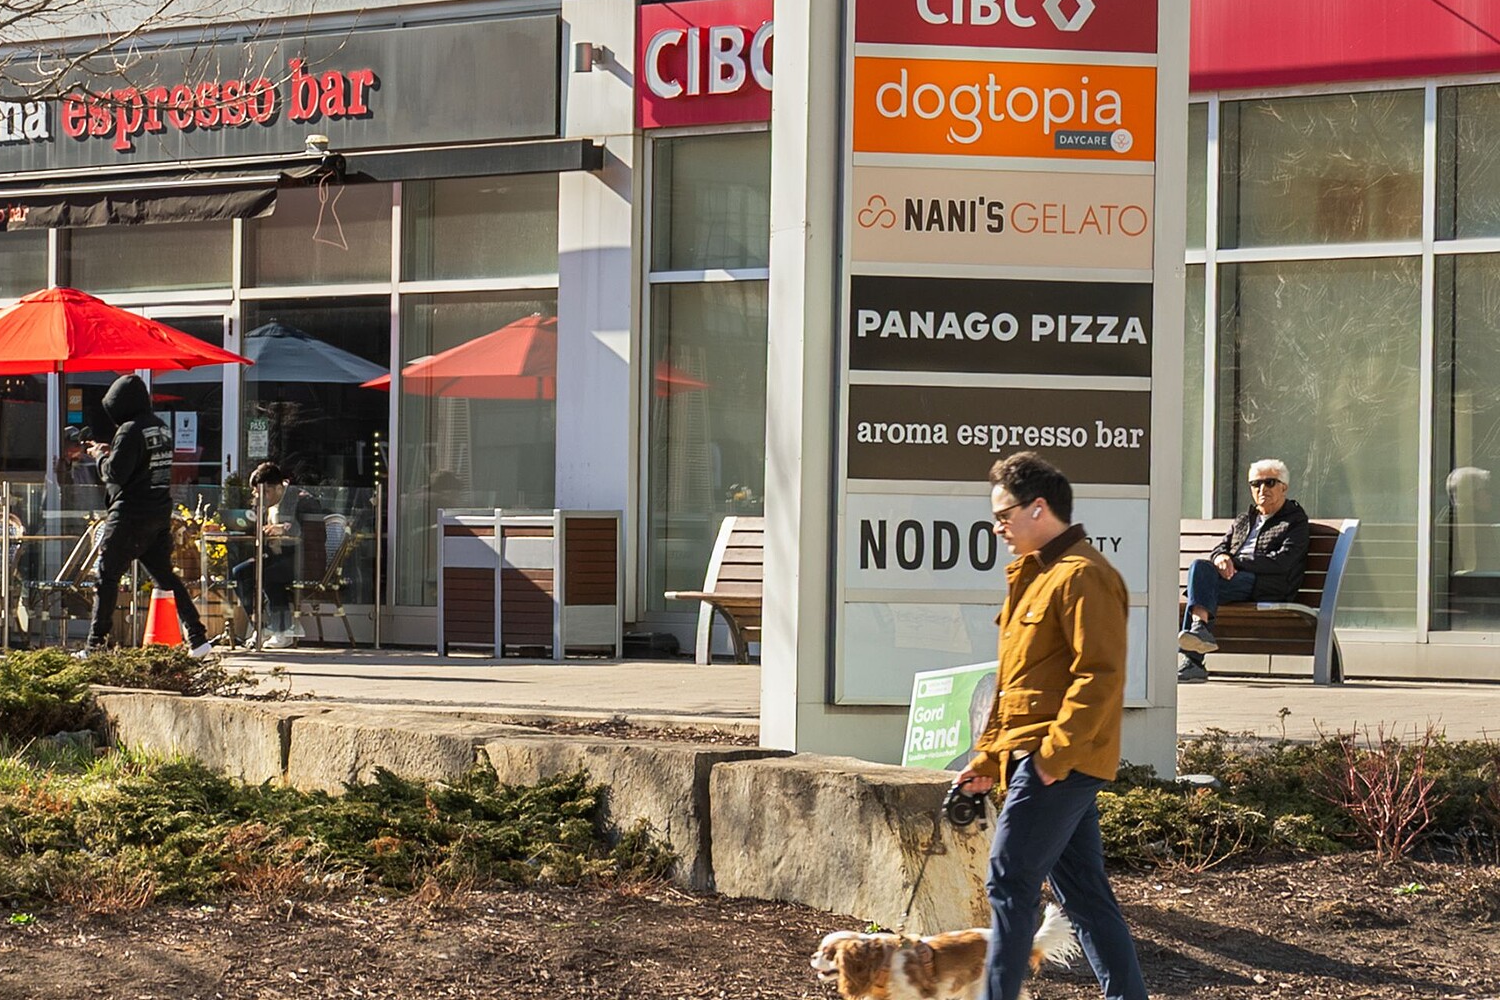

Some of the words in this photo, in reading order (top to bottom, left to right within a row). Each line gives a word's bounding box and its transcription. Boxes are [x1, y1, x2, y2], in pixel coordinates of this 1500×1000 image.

[62, 77, 276, 150] espresso
[288, 57, 375, 121] bar
[875, 68, 1123, 144] dogtopia
[1059, 134, 1107, 146] DAYCARE
[7, 203, 30, 222] bar
[904, 196, 1005, 234] NANI'S
[1010, 202, 1148, 237] GELATO
[857, 309, 1019, 342] PANAGO
[1031, 314, 1148, 345] PIZZA
[249, 420, 267, 431] PASS
[856, 421, 949, 445] aroma
[956, 423, 1088, 453] espresso
[1095, 420, 1145, 449] bar
[859, 519, 998, 571] NODO
[914, 703, 945, 724] Gord
[908, 719, 962, 753] Rand
